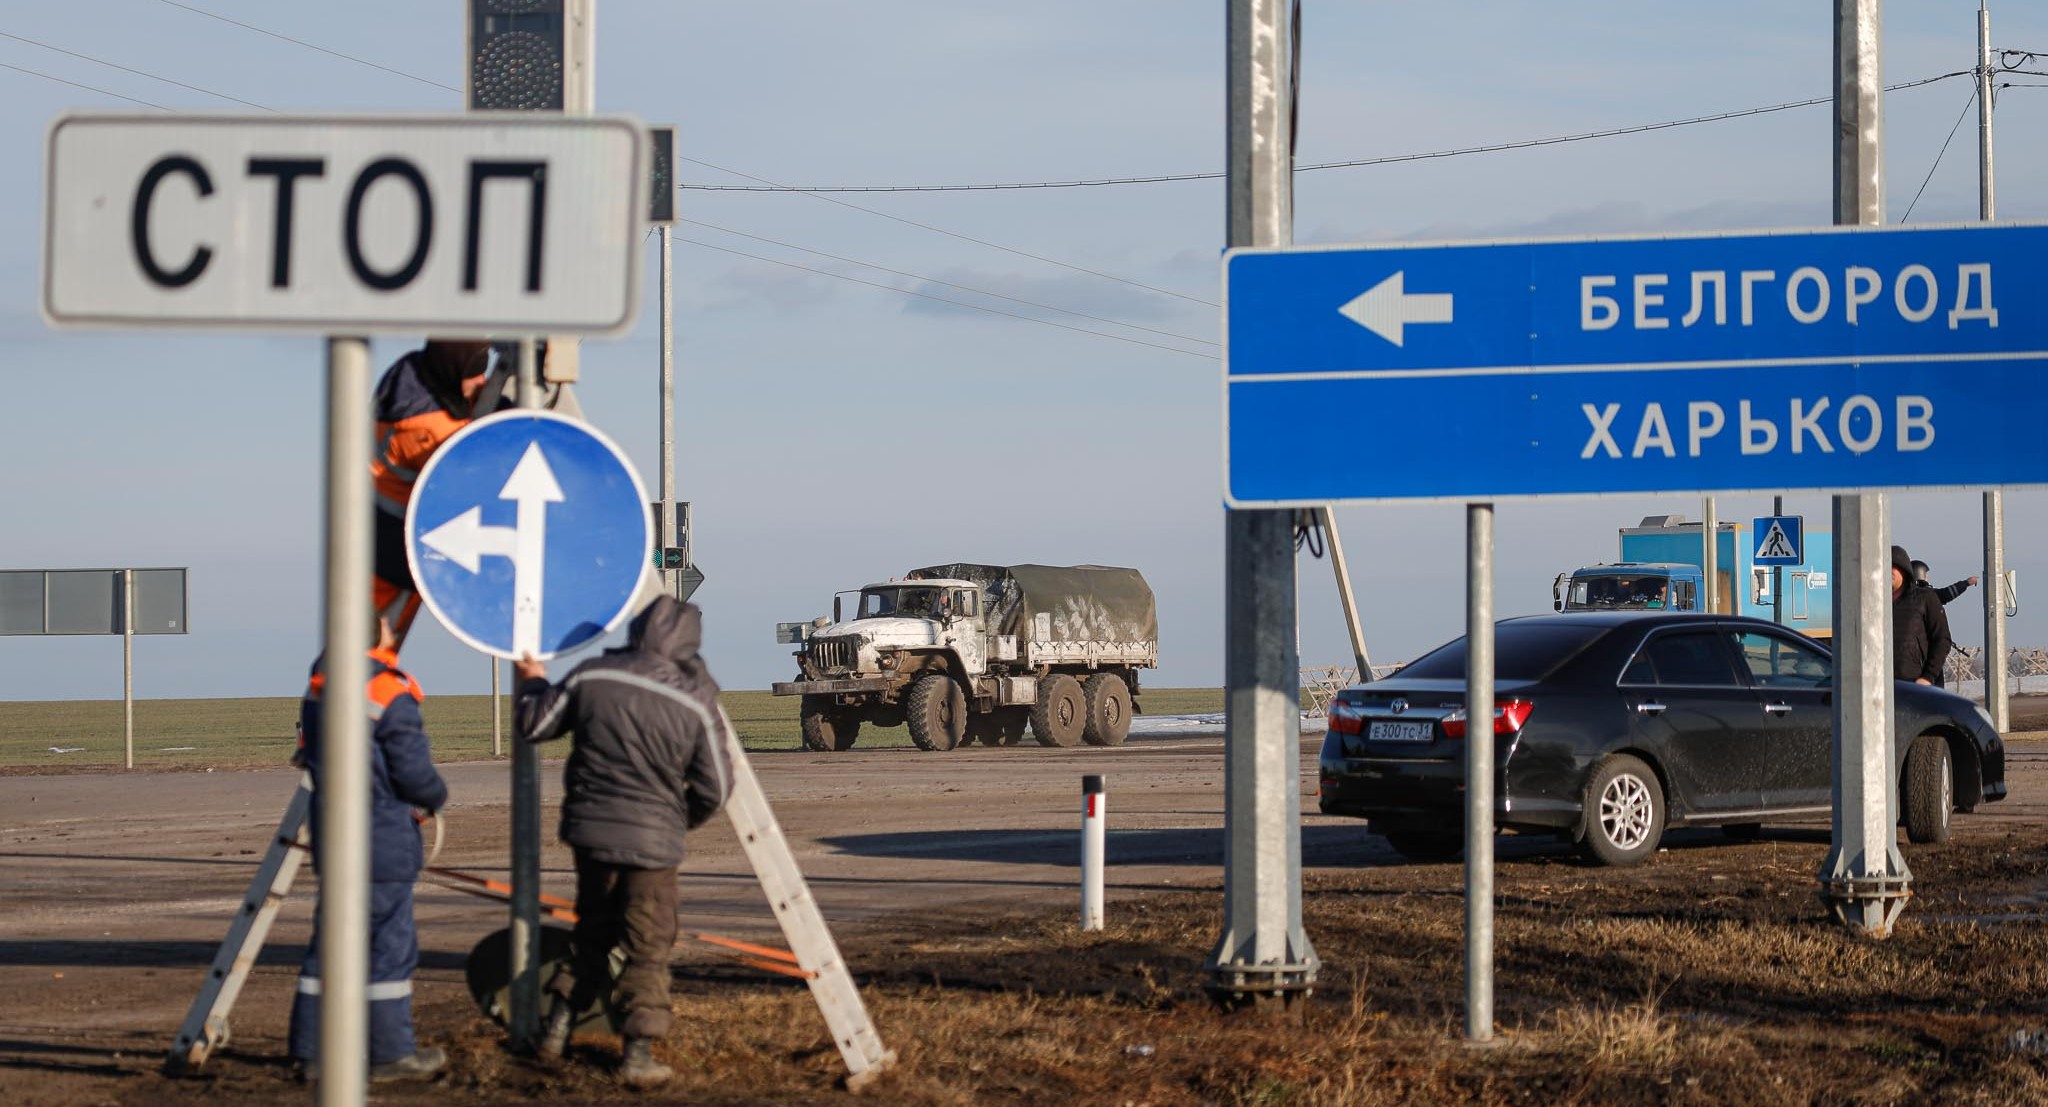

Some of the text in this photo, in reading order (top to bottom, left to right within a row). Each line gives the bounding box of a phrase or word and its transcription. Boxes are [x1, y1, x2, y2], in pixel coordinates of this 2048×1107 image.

[131, 154, 548, 293] СТОП
[1581, 263, 1998, 330] БЕЛГОРОД
[1581, 395, 1935, 458] ХАРЬКОВ
